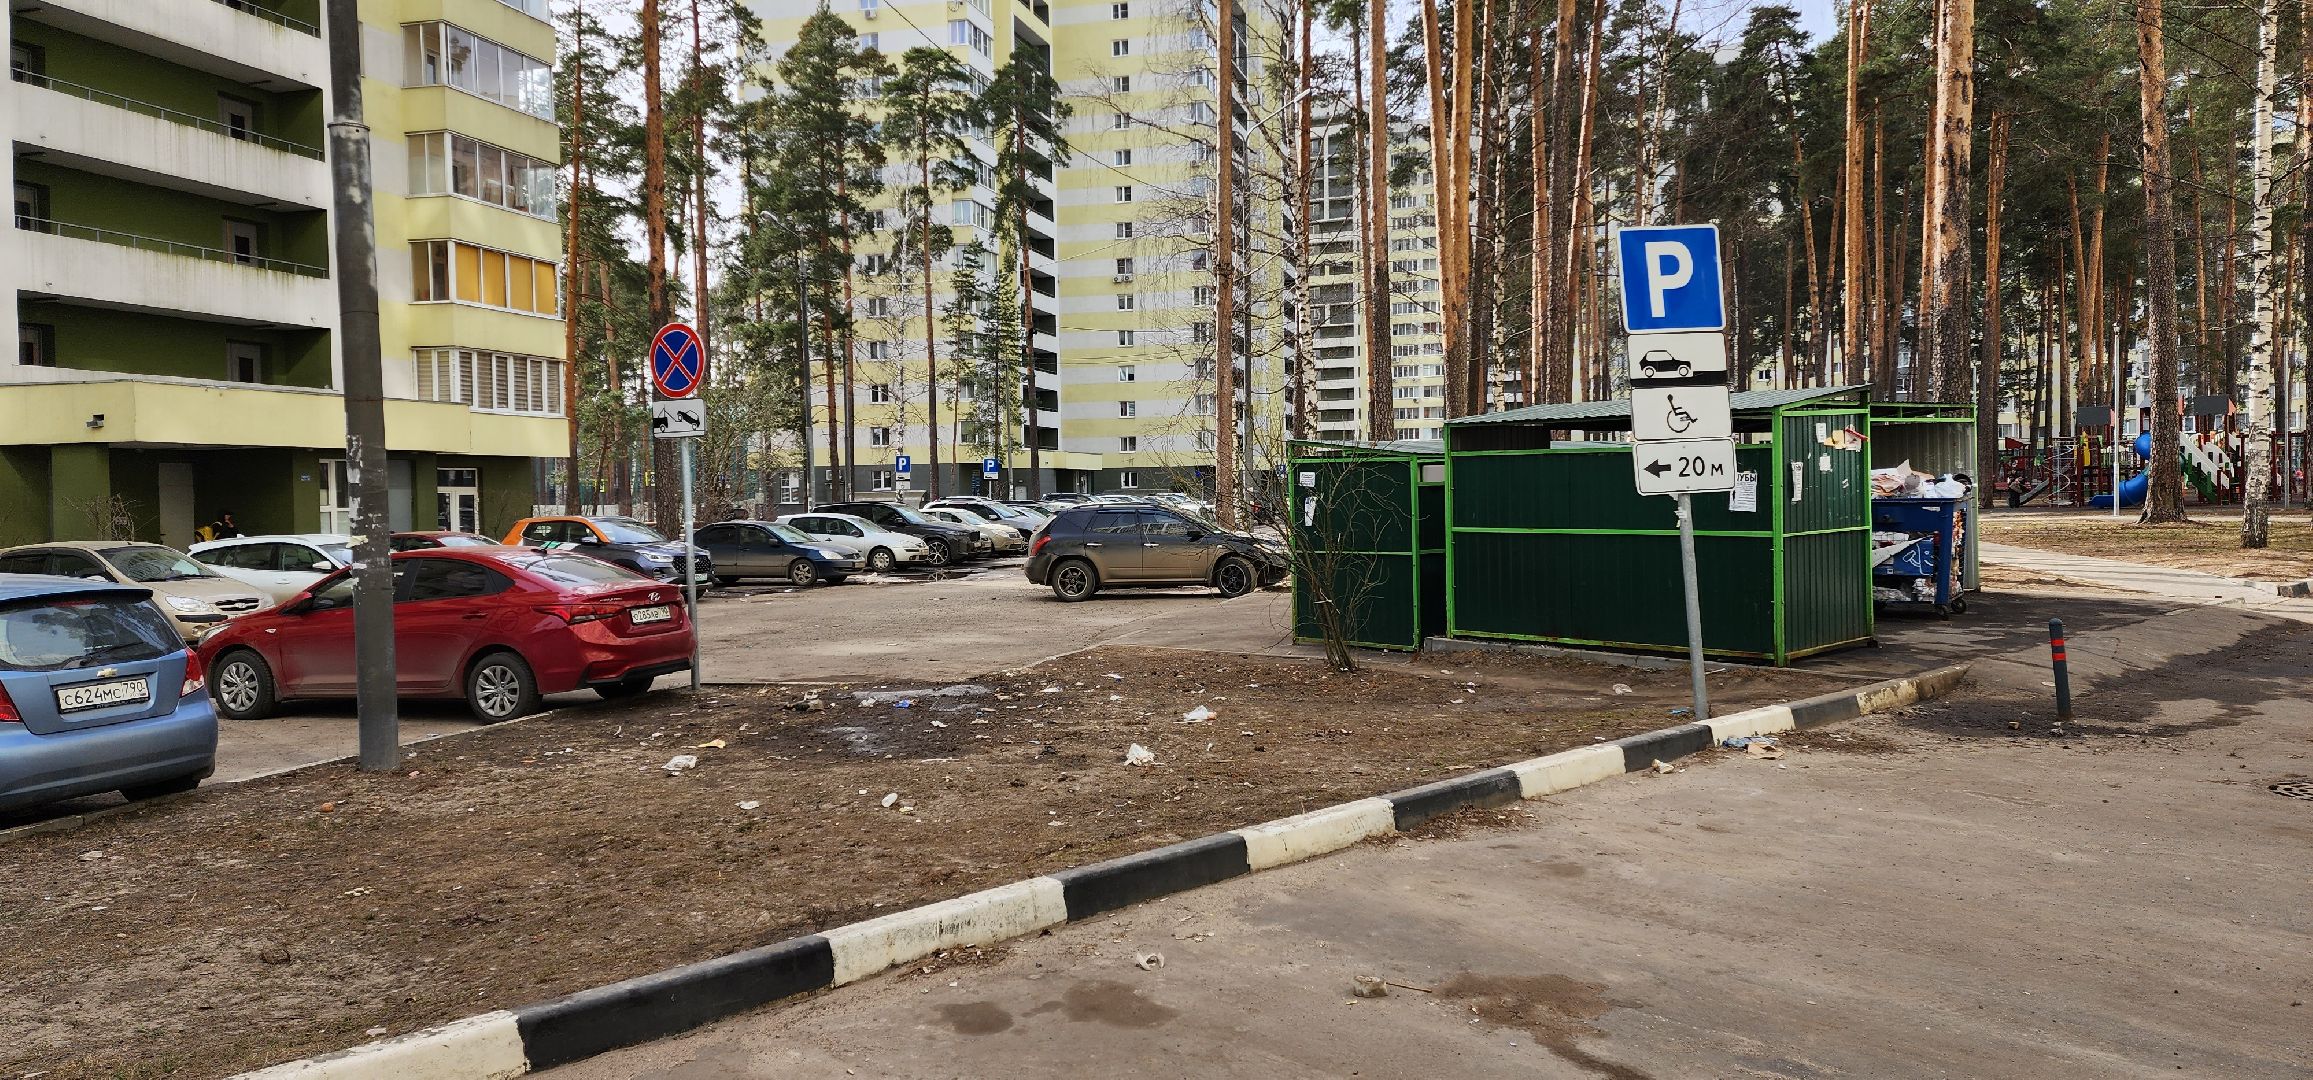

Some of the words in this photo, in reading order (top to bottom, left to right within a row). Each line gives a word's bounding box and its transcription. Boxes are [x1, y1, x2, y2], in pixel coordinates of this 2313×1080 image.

[1645, 241, 1694, 318] P
[898, 457, 907, 471] P
[987, 460, 995, 471] P
[1678, 456, 1706, 477] 20
